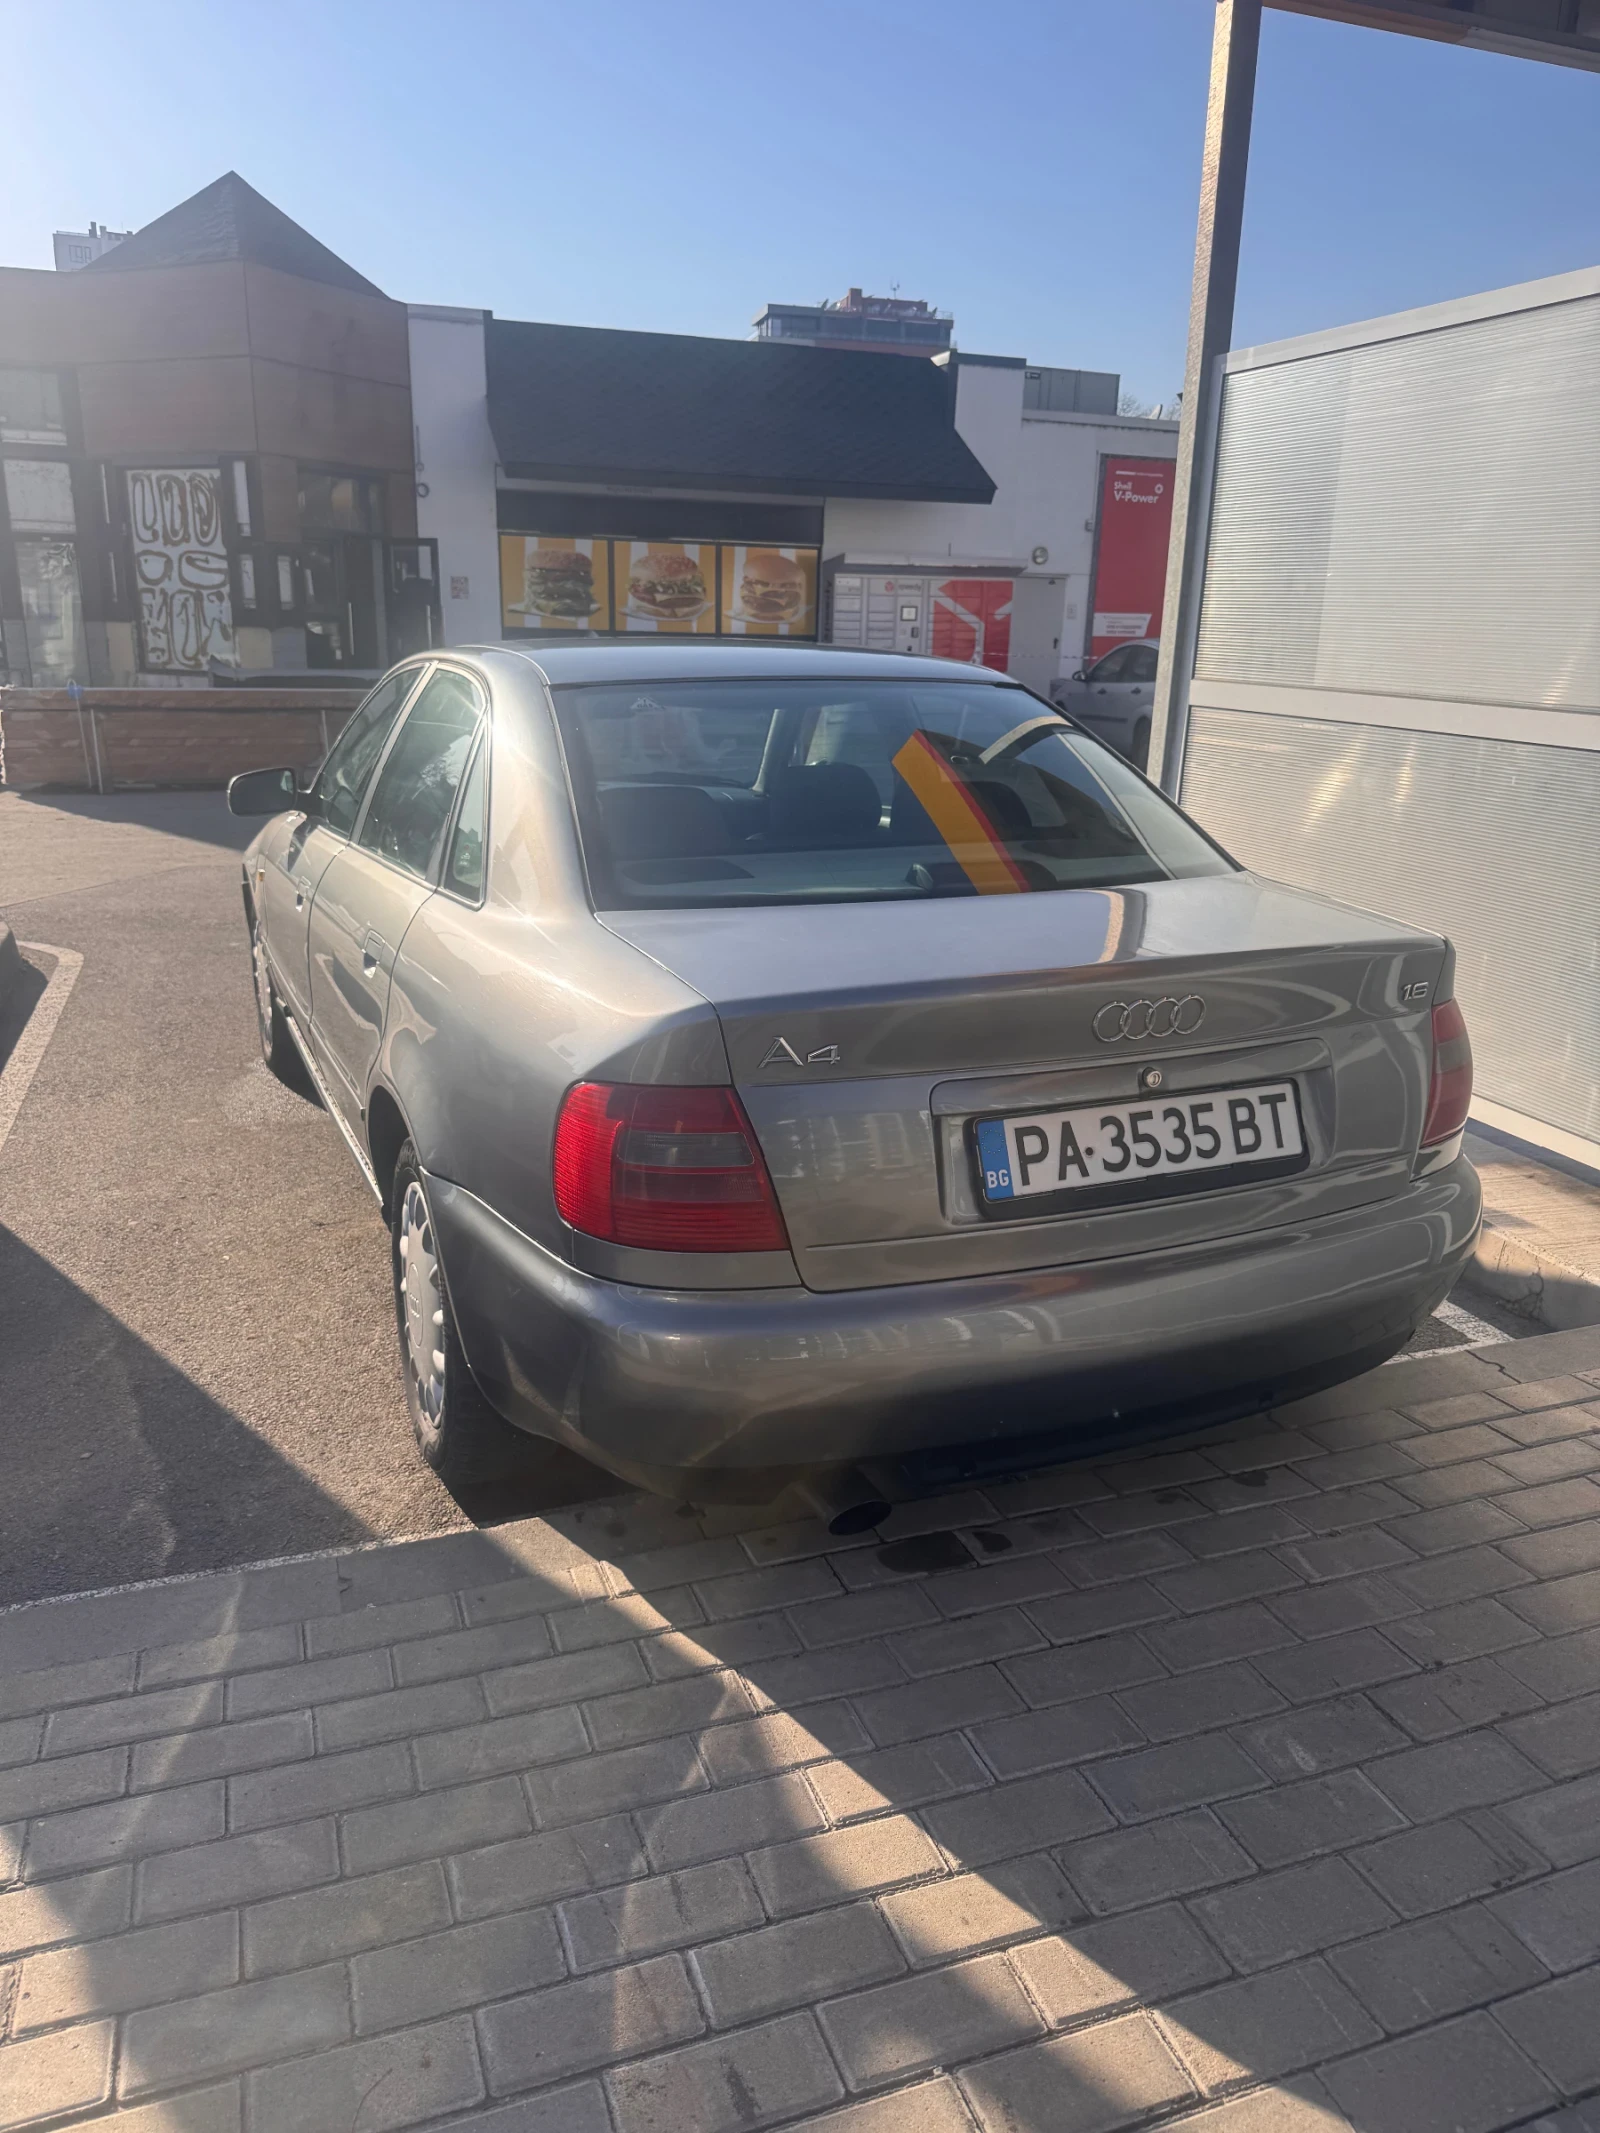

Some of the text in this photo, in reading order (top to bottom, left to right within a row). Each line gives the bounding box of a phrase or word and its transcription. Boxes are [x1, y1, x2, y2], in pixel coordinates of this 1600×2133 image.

[1114, 481, 1132, 490] Shell
[1114, 490, 1159, 503] V-Power
[757, 1036, 840, 1068] A4
[1014, 1092, 1287, 1187] PA 3535 BT
[987, 1169, 1009, 1188] BG
